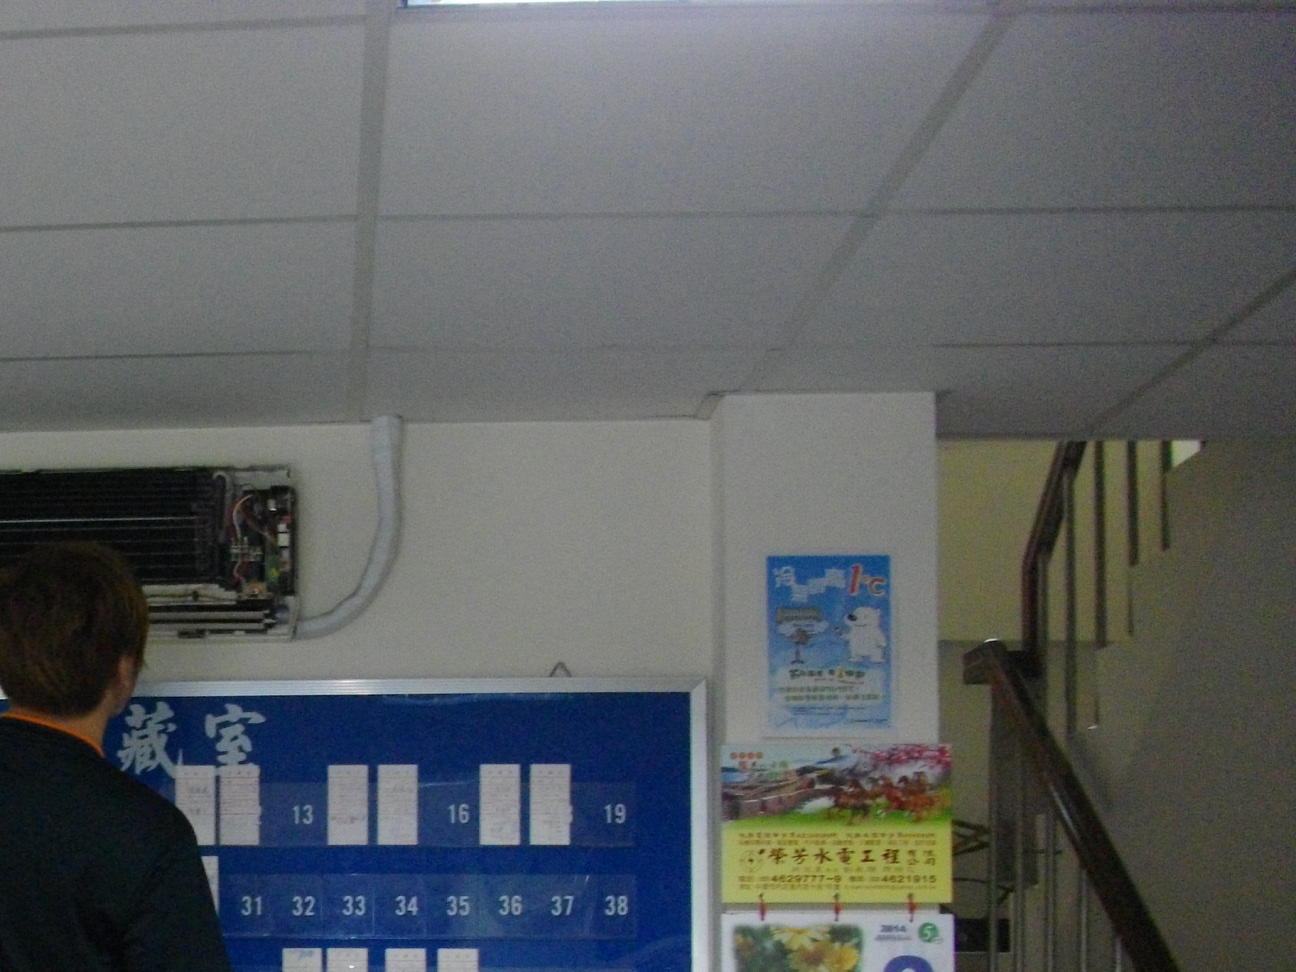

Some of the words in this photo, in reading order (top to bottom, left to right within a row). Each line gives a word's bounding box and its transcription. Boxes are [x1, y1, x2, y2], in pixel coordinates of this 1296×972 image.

[291, 803, 315, 826] 13
[447, 802, 471, 825] 16
[603, 802, 628, 825] 19
[240, 894, 264, 917] 31
[291, 894, 317, 918] 32
[341, 894, 367, 917] 33
[394, 894, 420, 917] 34
[446, 894, 472, 918] 35
[497, 893, 524, 917] 36
[550, 893, 576, 917] 37
[603, 893, 630, 917] 38
